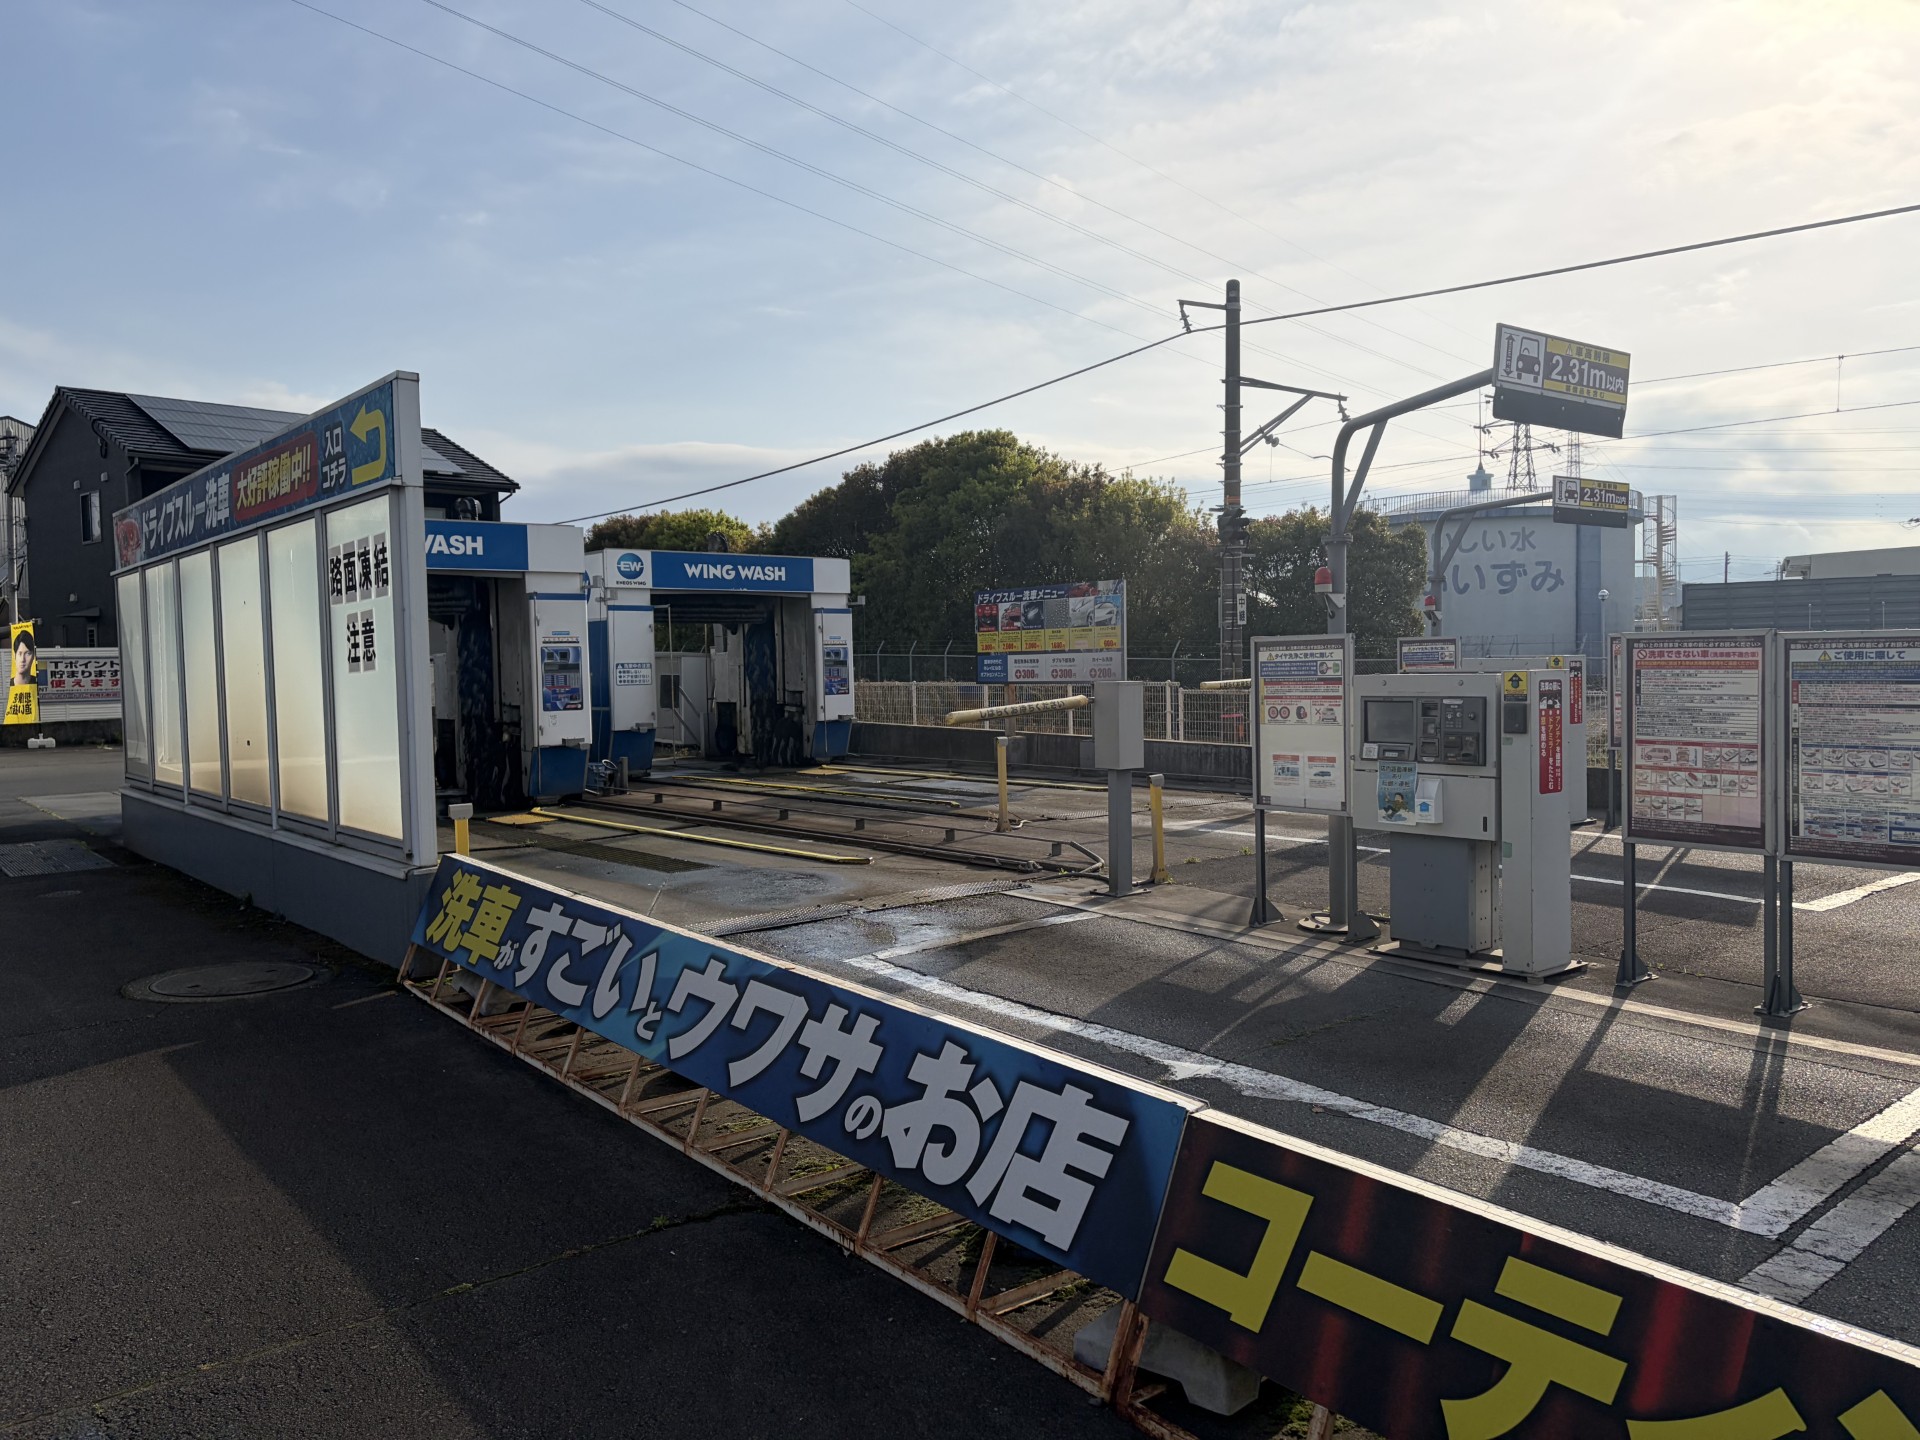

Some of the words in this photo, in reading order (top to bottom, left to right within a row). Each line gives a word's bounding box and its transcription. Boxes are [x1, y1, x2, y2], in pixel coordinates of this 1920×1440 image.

[325, 426, 342, 458] 入口
[322, 457, 347, 490] コチラ
[141, 473, 231, 552] ドライブスルー洗車
[1431, 526, 1536, 553] しい水
[329, 542, 389, 596] 路面凍結
[620, 561, 642, 571] EW
[684, 563, 735, 580] WING
[738, 565, 786, 582] WASH
[1424, 560, 1564, 595] いずみ
[977, 589, 1065, 604] ドライブスルー洗車メニュー
[347, 618, 376, 664] 注意
[49, 660, 120, 670] Tポイント
[1834, 650, 1906, 660] ご使用に際して
[50, 669, 120, 679] 貯まります
[50, 678, 120, 689] 使えます
[425, 868, 1130, 1252] 洗車がすごいとウワサのお店
